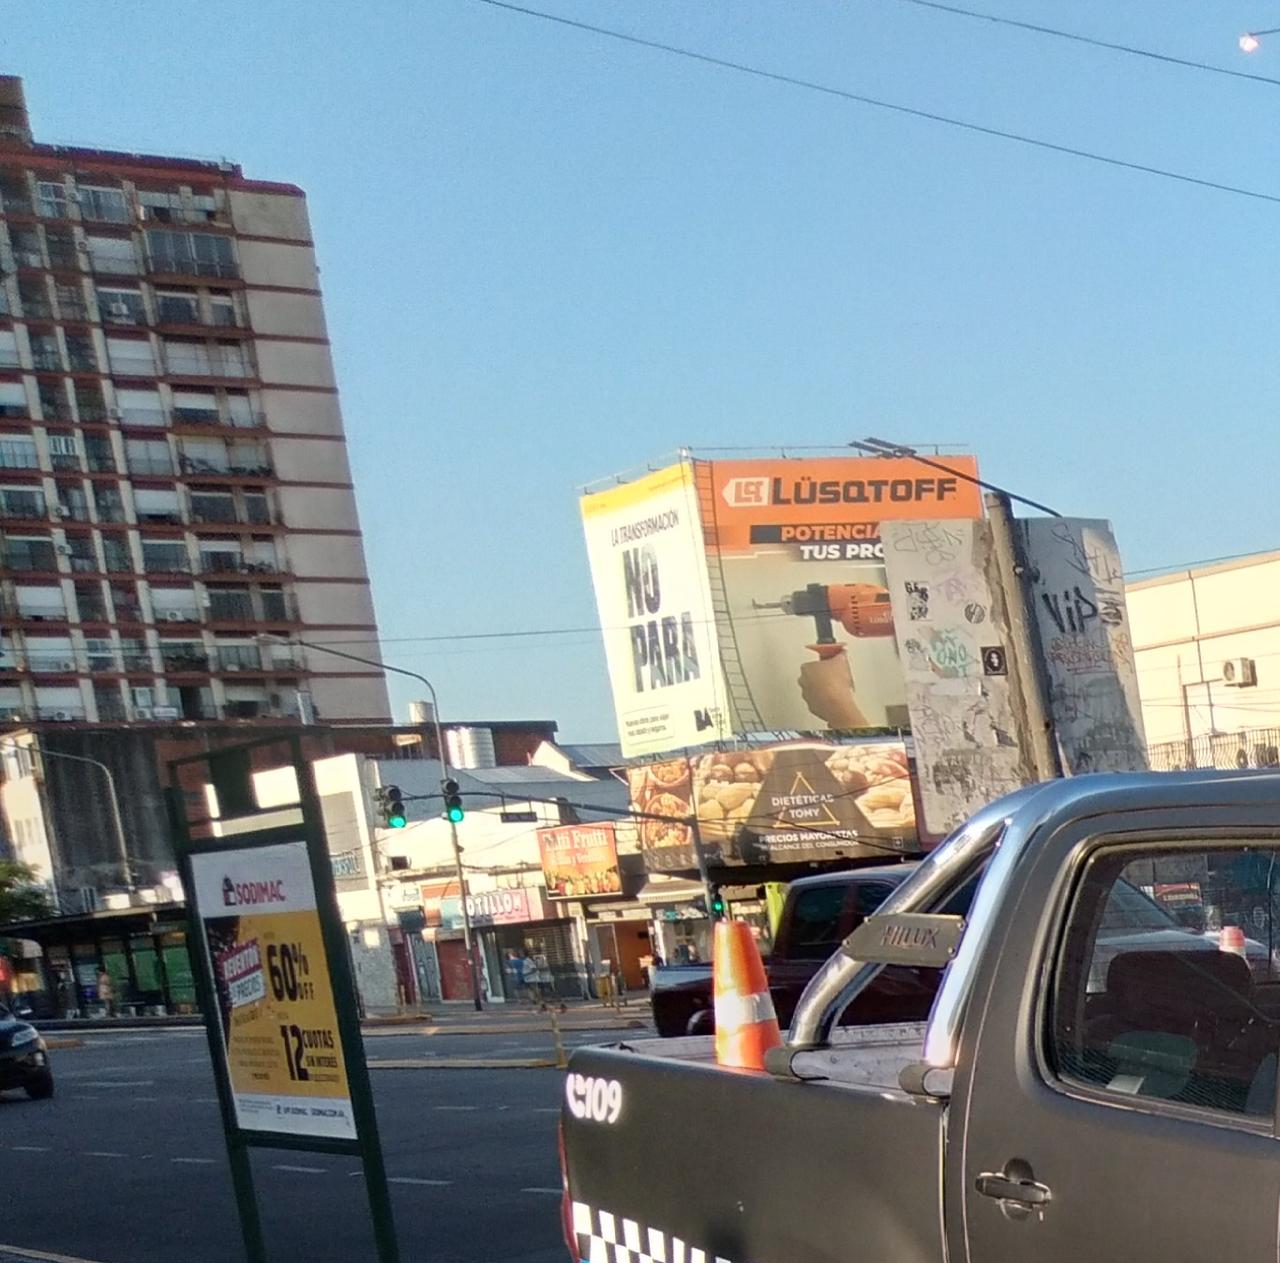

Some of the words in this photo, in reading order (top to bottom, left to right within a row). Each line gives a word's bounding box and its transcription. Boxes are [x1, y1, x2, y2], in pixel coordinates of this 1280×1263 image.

[619, 508, 680, 545] TRANSFORMACIÓN
[800, 543, 842, 560] TUS
[845, 542, 886, 560] PRO
[622, 544, 662, 619] NO
[629, 610, 701, 693] PARA
[771, 793, 835, 806] DIETÉTICAS
[789, 808, 820, 819] TOMY
[759, 832, 799, 844] PRECIOS
[235, 879, 286, 906] SODIMAC
[881, 925, 940, 950] HILUX
[280, 1023, 310, 1081] 12
[302, 1029, 335, 1050] CUOTAS
